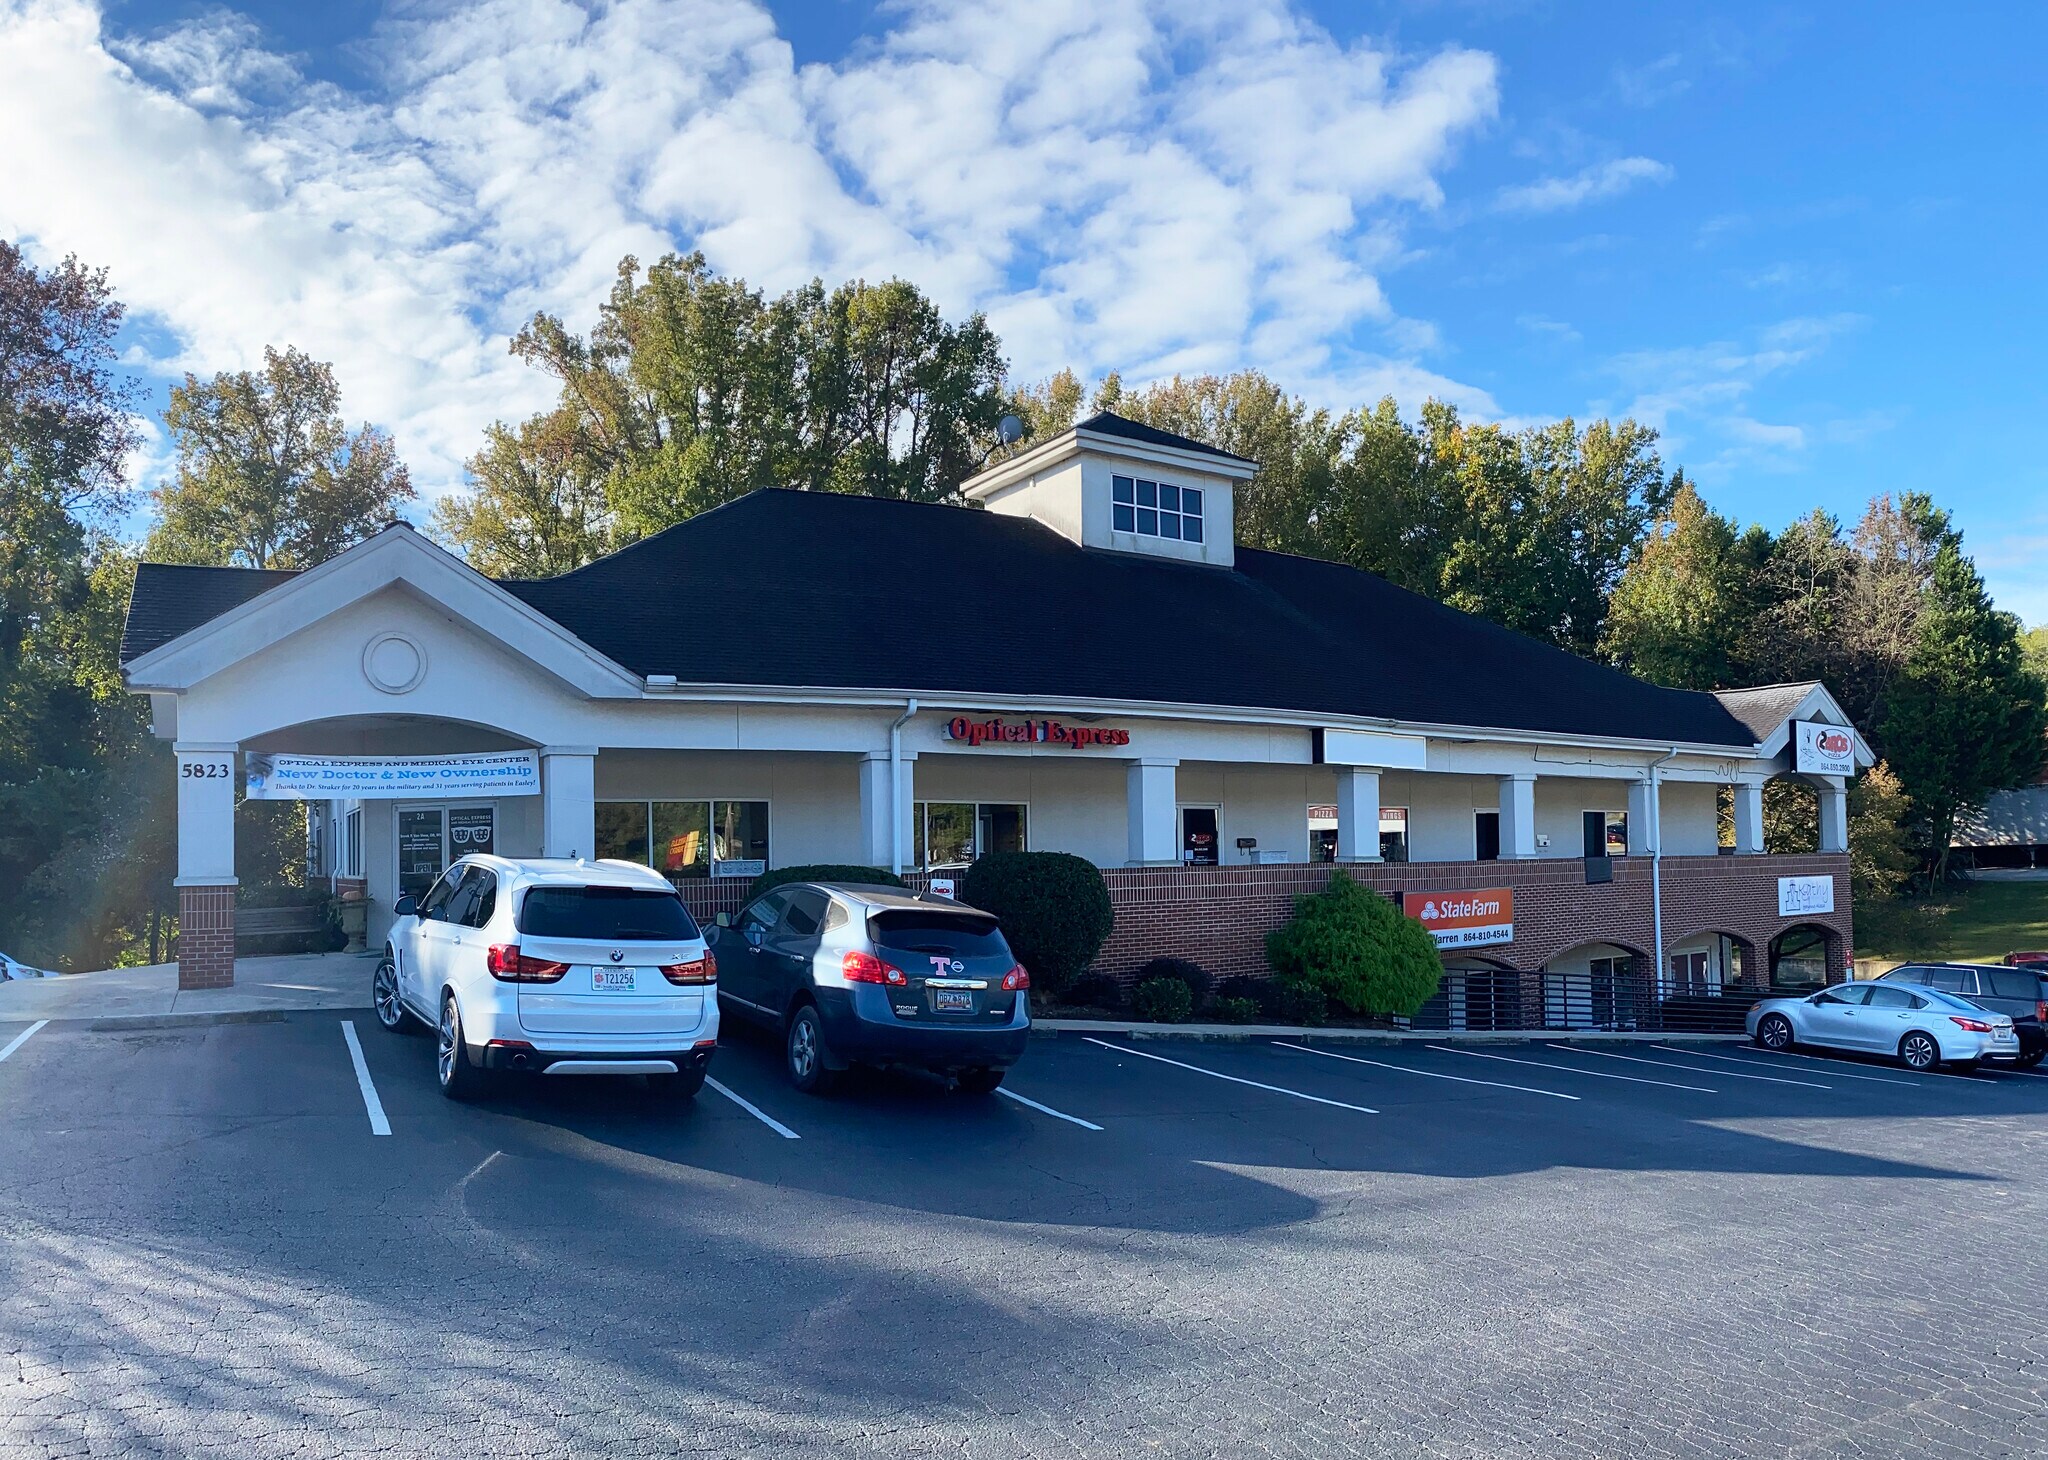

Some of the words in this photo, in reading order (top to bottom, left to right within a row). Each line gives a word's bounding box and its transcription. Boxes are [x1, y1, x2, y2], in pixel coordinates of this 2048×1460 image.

[949, 715, 1038, 746] Optical
[1043, 720, 1130, 749] Express
[279, 759, 329, 767] OPTICAL
[486, 756, 530, 764] CENTER
[181, 763, 229, 778] 5823
[277, 769, 318, 779] New
[322, 770, 377, 779] Doctor
[381, 770, 394, 779] &
[397, 770, 437, 779] New
[440, 765, 532, 778] Ownership
[341, 783, 351, 791] for
[483, 780, 506, 788] patients
[514, 779, 536, 787] Easley!
[416, 813, 425, 821] 2A
[1314, 810, 1334, 818] PIZZA
[1381, 812, 1402, 820] WINGS
[1463, 929, 1509, 942] 864-810-4544
[605, 973, 635, 984] T21256
